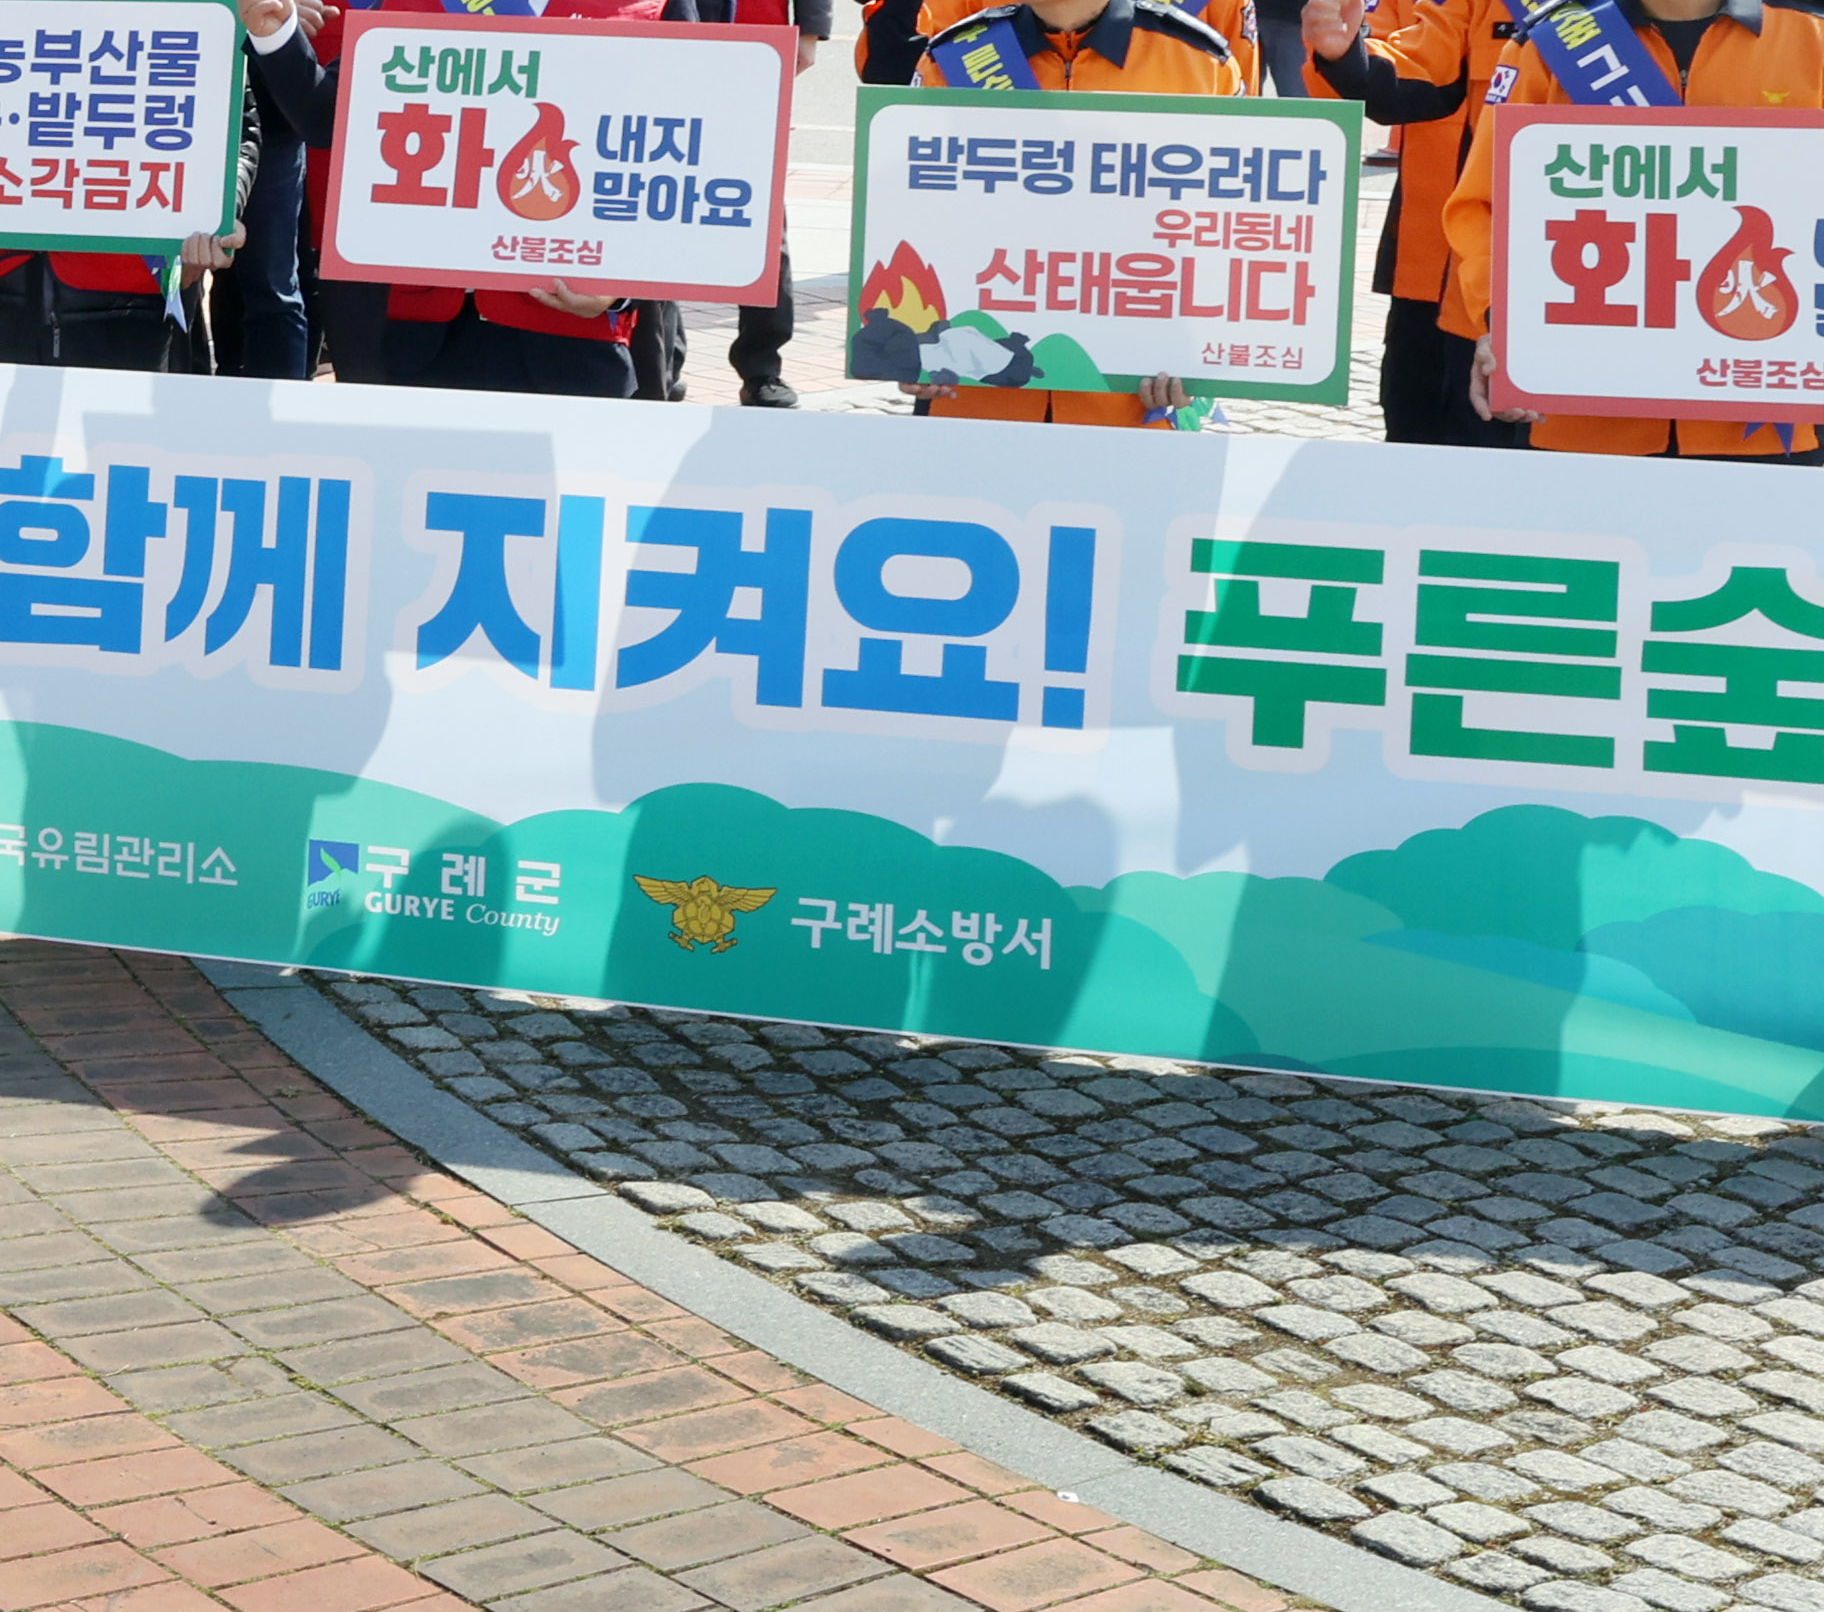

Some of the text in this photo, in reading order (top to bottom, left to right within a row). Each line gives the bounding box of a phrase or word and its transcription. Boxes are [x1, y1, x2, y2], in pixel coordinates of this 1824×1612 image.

[381, 46, 541, 98] 산에서
[371, 103, 495, 209] 화
[597, 113, 701, 167] 내지
[907, 136, 1327, 205] 밭두렁 태우려다
[1545, 143, 1738, 202] 산에서
[592, 174, 753, 228] 말아요
[491, 236, 603, 267] 산불조심
[1153, 209, 1313, 253] 우리동네
[975, 246, 1316, 325] 산태웁니다
[1544, 209, 1691, 329] 화
[1201, 342, 1304, 371] 산불조심
[417, 491, 1096, 730] 지켜요!
[365, 845, 561, 905] 구례군
[364, 891, 561, 937] GURYE County
[790, 896, 1054, 970] 구례소방서
